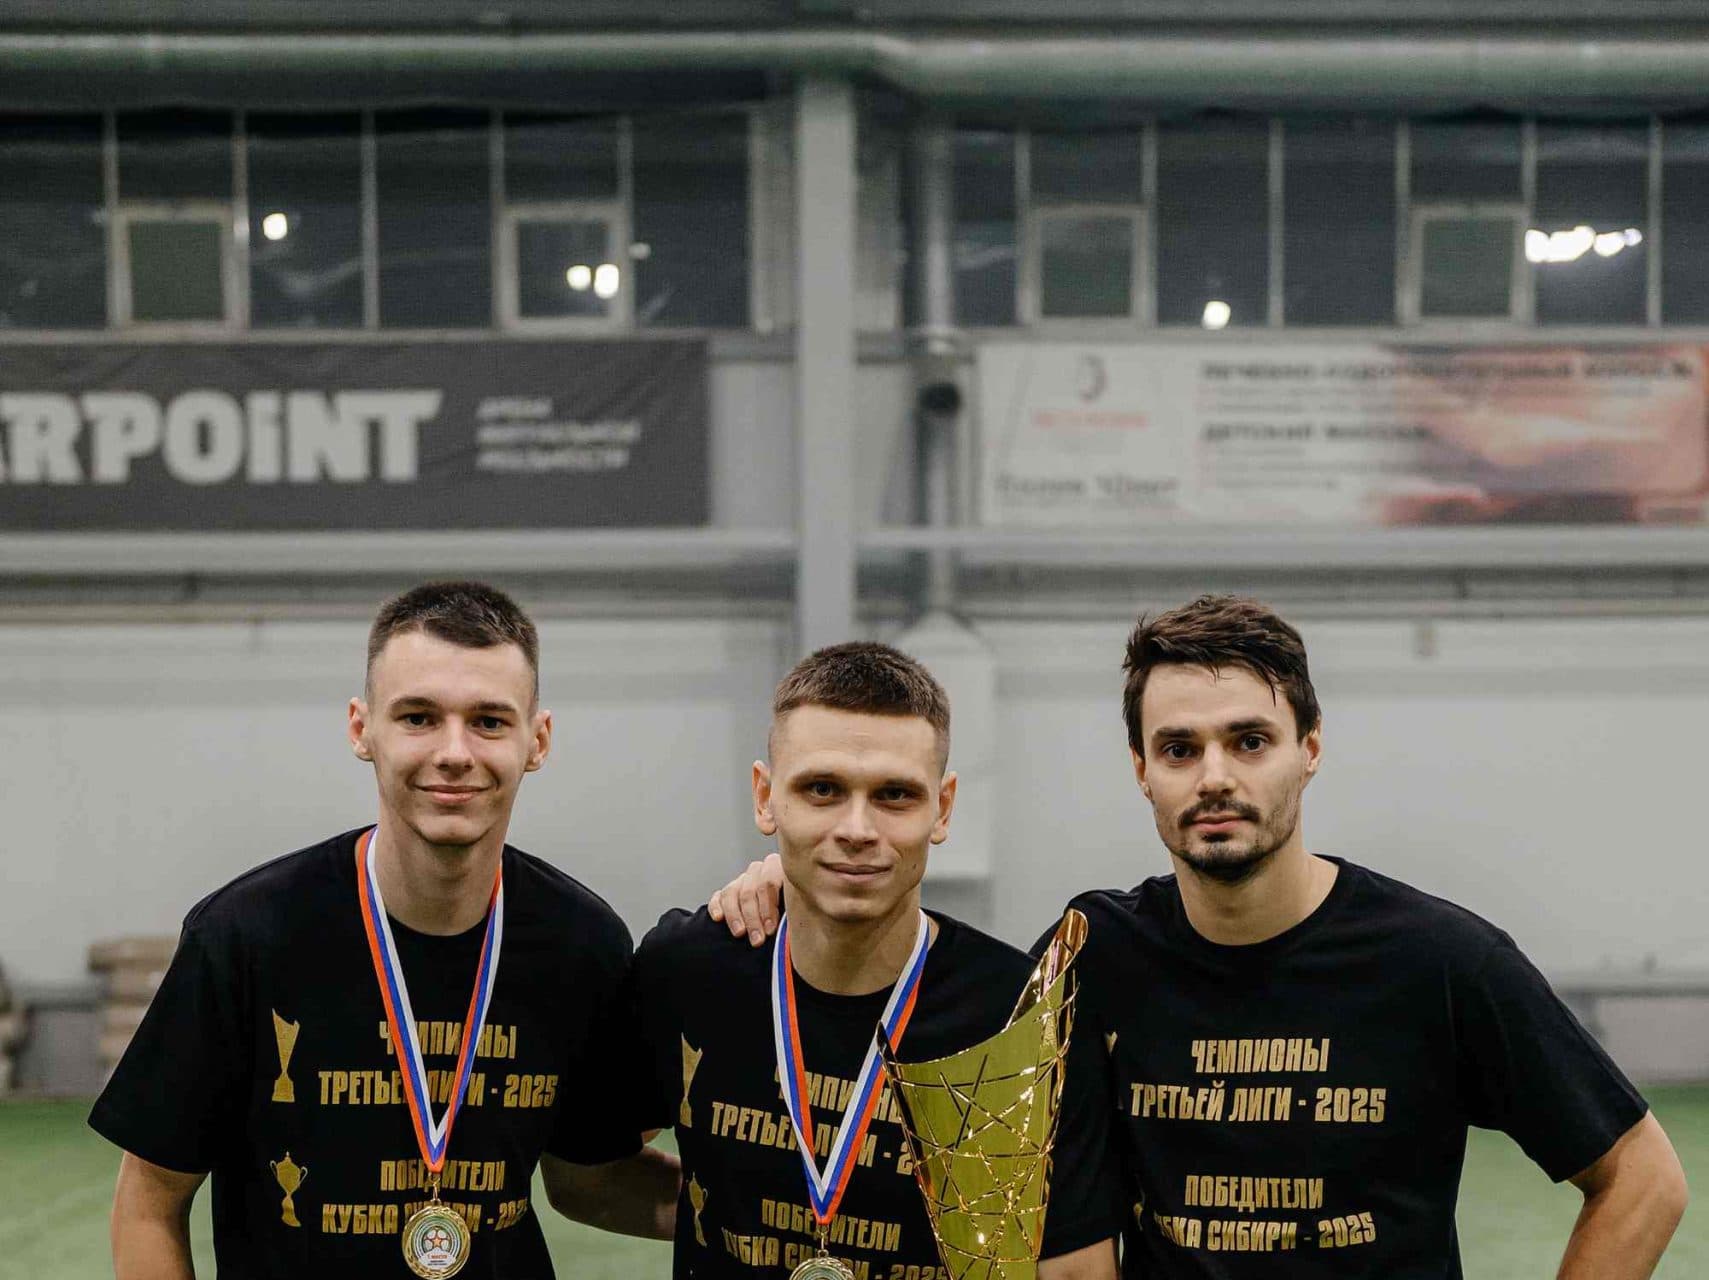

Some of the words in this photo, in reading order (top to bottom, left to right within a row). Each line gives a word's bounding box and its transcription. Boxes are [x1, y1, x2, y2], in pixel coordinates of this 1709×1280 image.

[1192, 1038, 1330, 1073] ЧЕМПИОНЫ
[318, 1070, 406, 1105] ТРЕТЬЕ
[426, 1070, 486, 1106] ЛИИ
[503, 1074, 559, 1108] 2025
[1130, 1080, 1225, 1121] ТРЕТЬЕЙ
[1229, 1087, 1292, 1122] ЛИГИ
[1315, 1087, 1387, 1122] 2025
[1184, 1175, 1324, 1213] ПОБЕДИТЕЛИ
[322, 1204, 398, 1234] КУБКА
[1207, 1220, 1297, 1252] СИБИРИ
[1318, 1211, 1376, 1249] 2025
